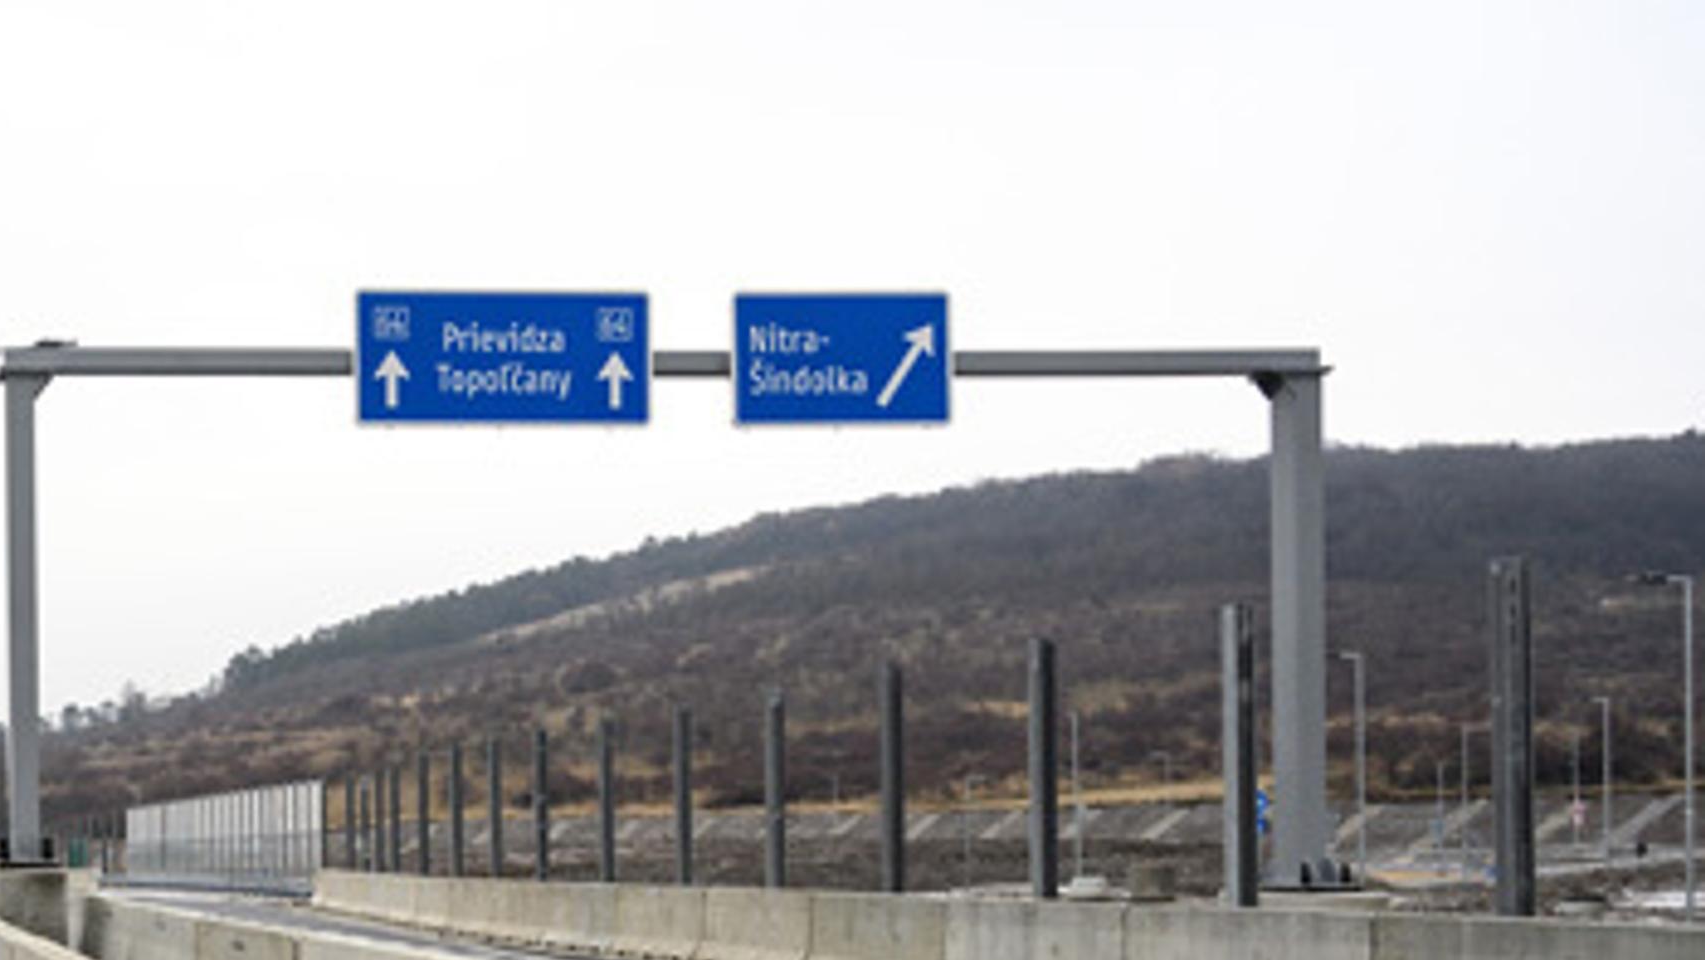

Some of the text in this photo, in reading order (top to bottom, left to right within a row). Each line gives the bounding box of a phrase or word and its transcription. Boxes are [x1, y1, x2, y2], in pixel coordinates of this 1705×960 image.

[442, 321, 566, 352] Prievidza
[749, 321, 830, 353] Nitra-
[436, 361, 572, 400] Topoľčany
[750, 358, 868, 396] Šindolka
